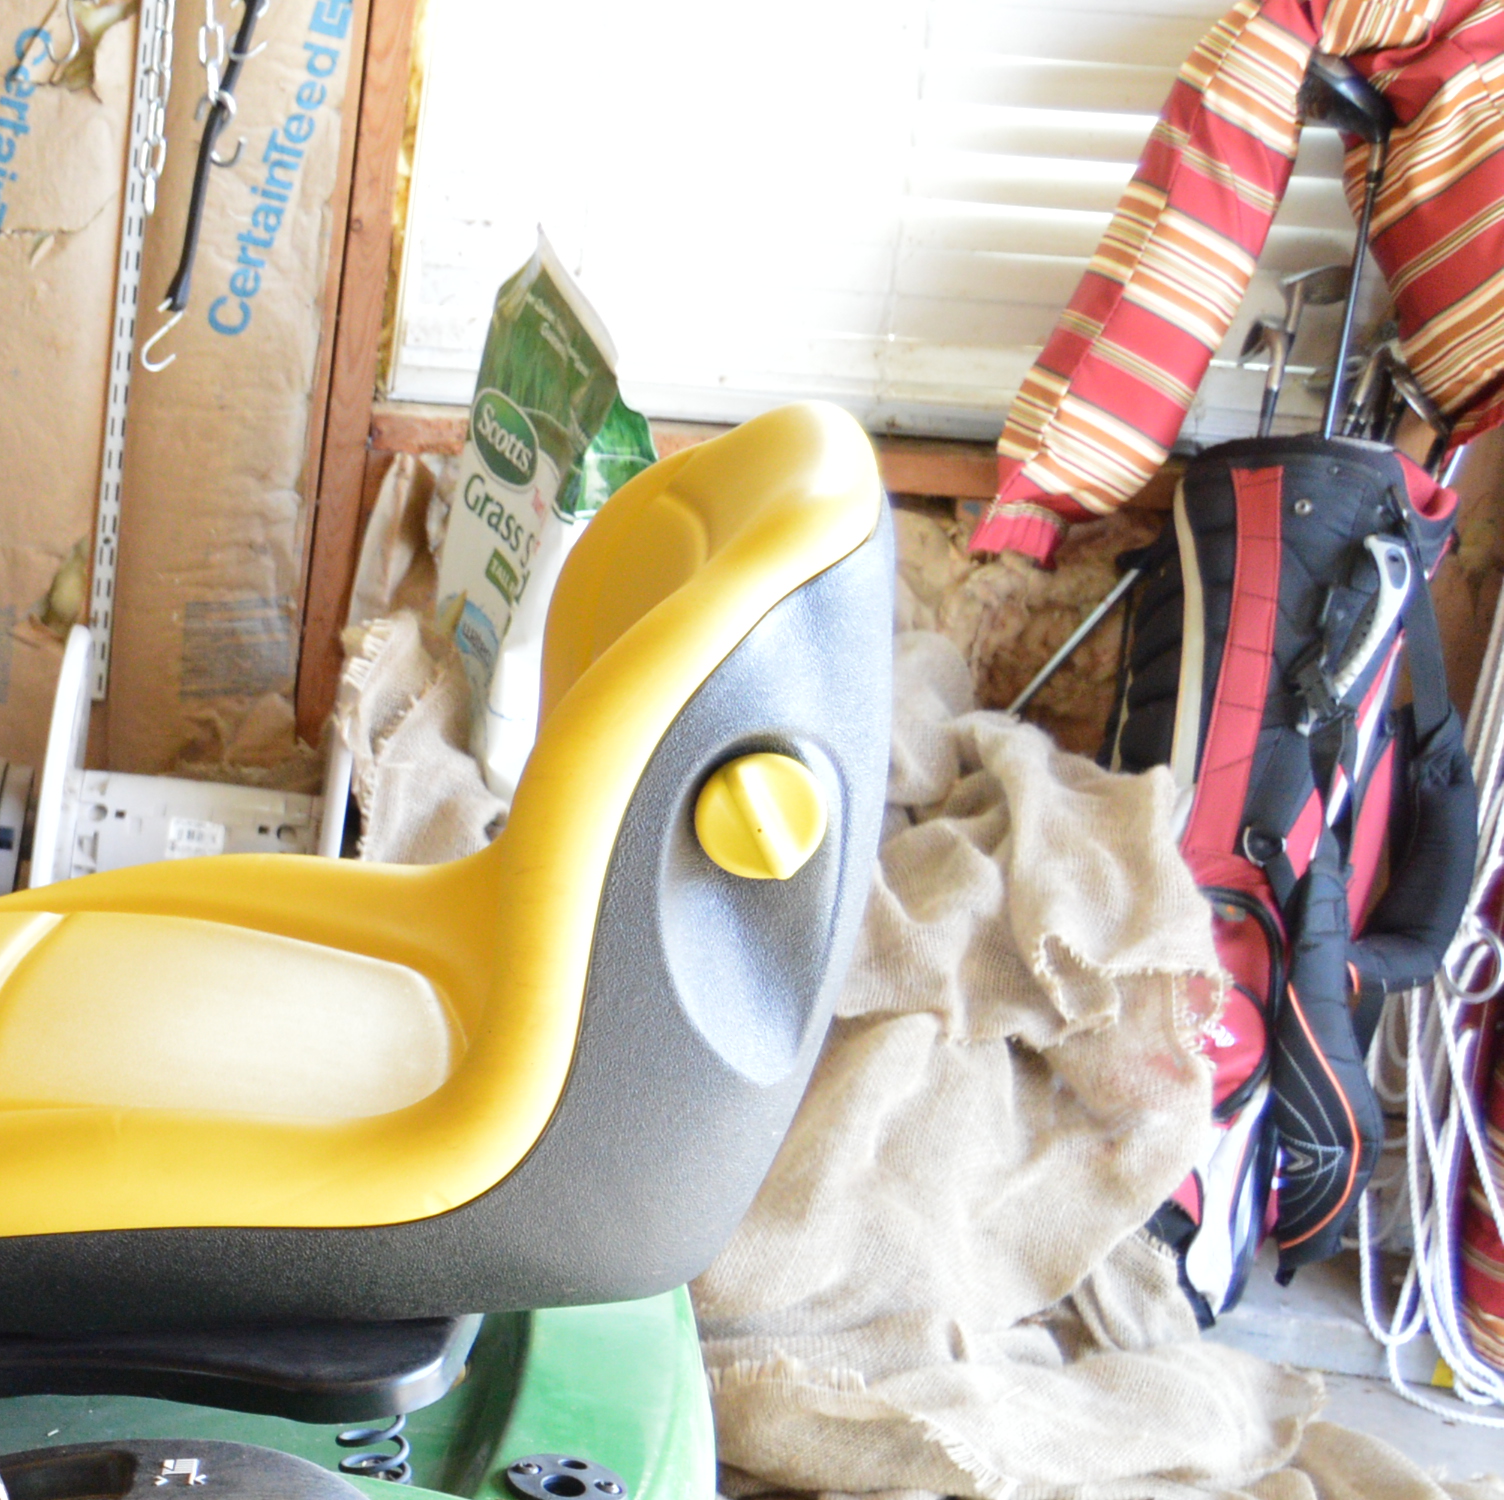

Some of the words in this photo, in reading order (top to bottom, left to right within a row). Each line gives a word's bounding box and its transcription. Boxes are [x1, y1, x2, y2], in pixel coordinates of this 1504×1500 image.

[208, 40, 342, 336] CertainTeed
[478, 403, 534, 476] Scotts
[464, 473, 525, 553] Grass
